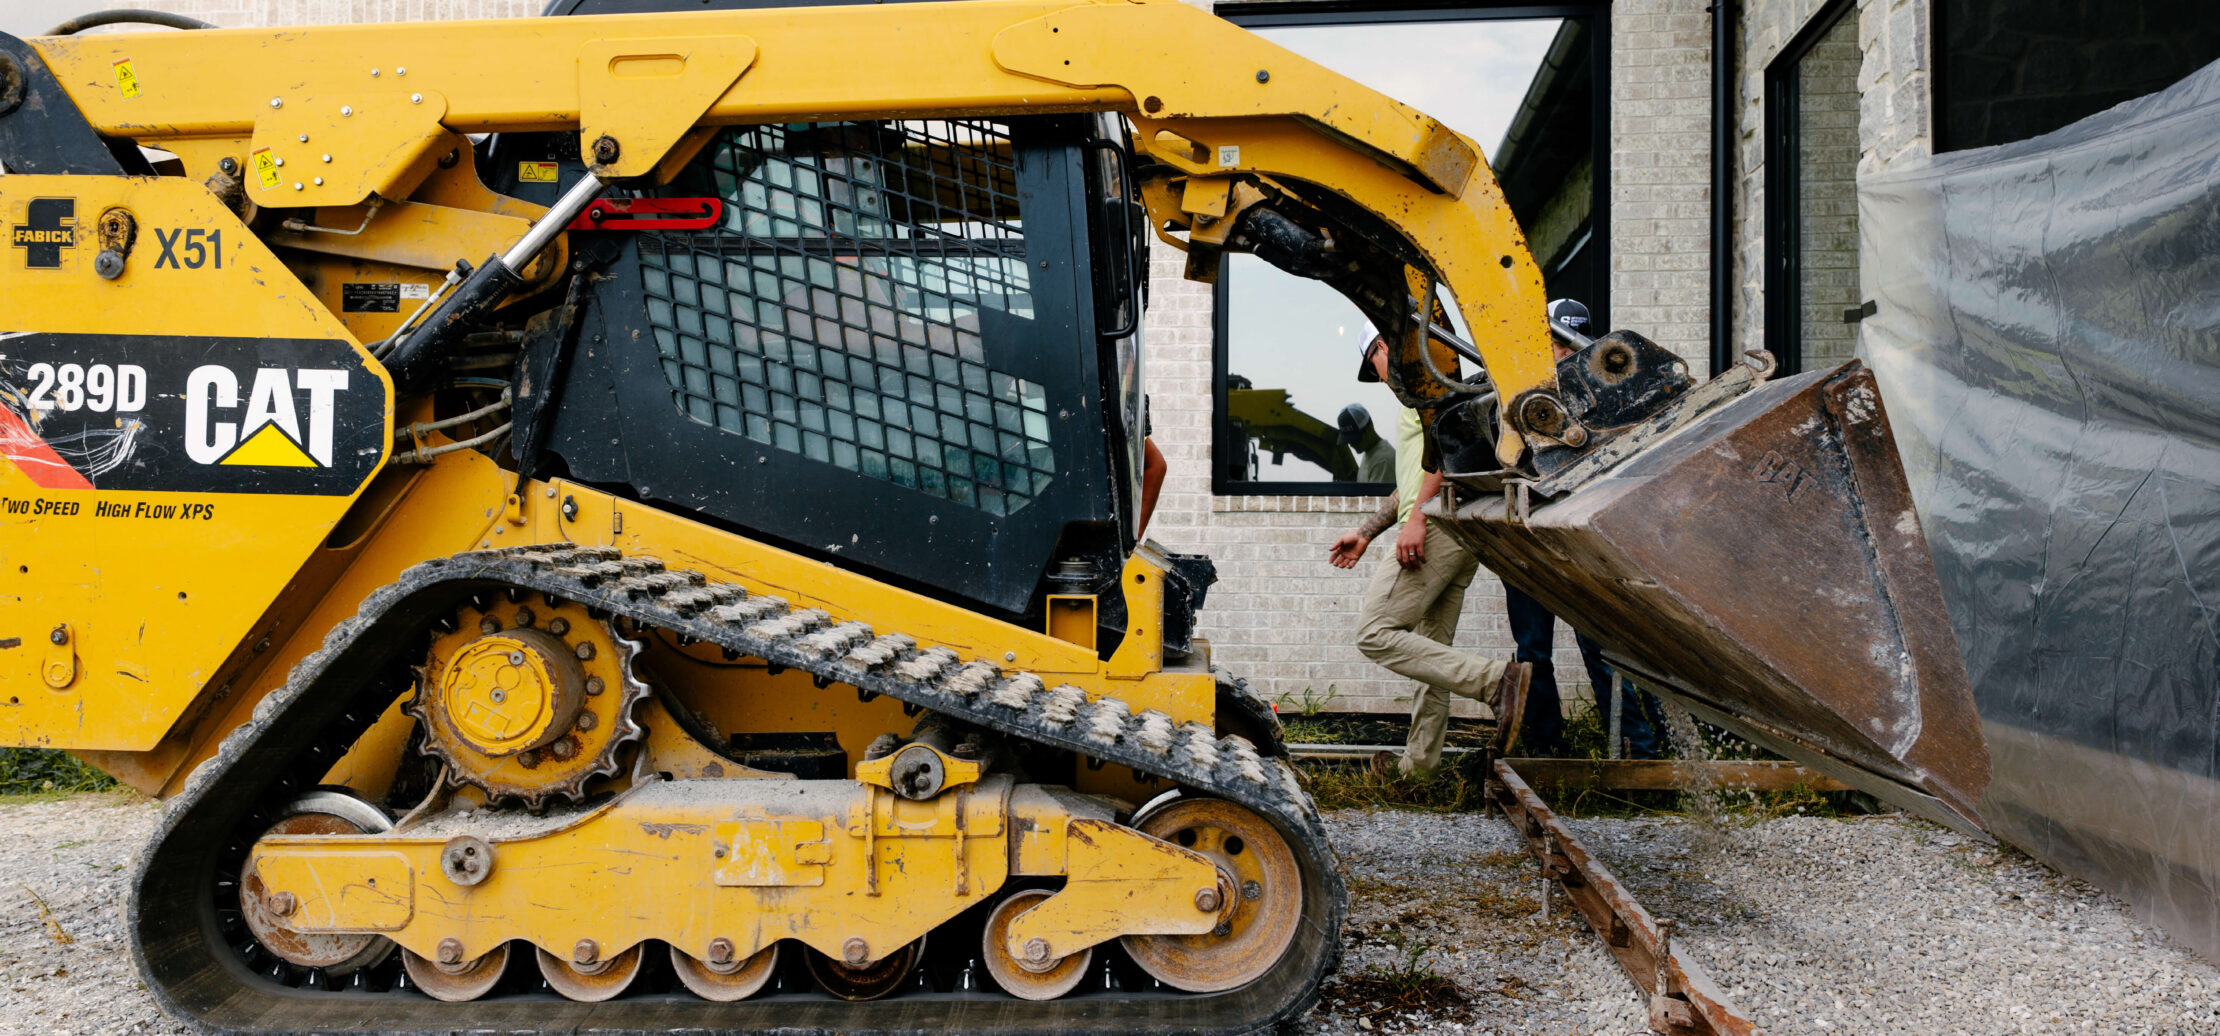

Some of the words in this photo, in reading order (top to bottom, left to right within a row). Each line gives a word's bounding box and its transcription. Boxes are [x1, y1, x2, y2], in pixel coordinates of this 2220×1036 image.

[15, 230, 73, 243] FABICK
[153, 228, 222, 269] X51
[26, 362, 147, 412] 289D
[184, 364, 349, 468] CAT
[1752, 450, 1818, 500] CAT
[180, 503, 215, 521] XPS
